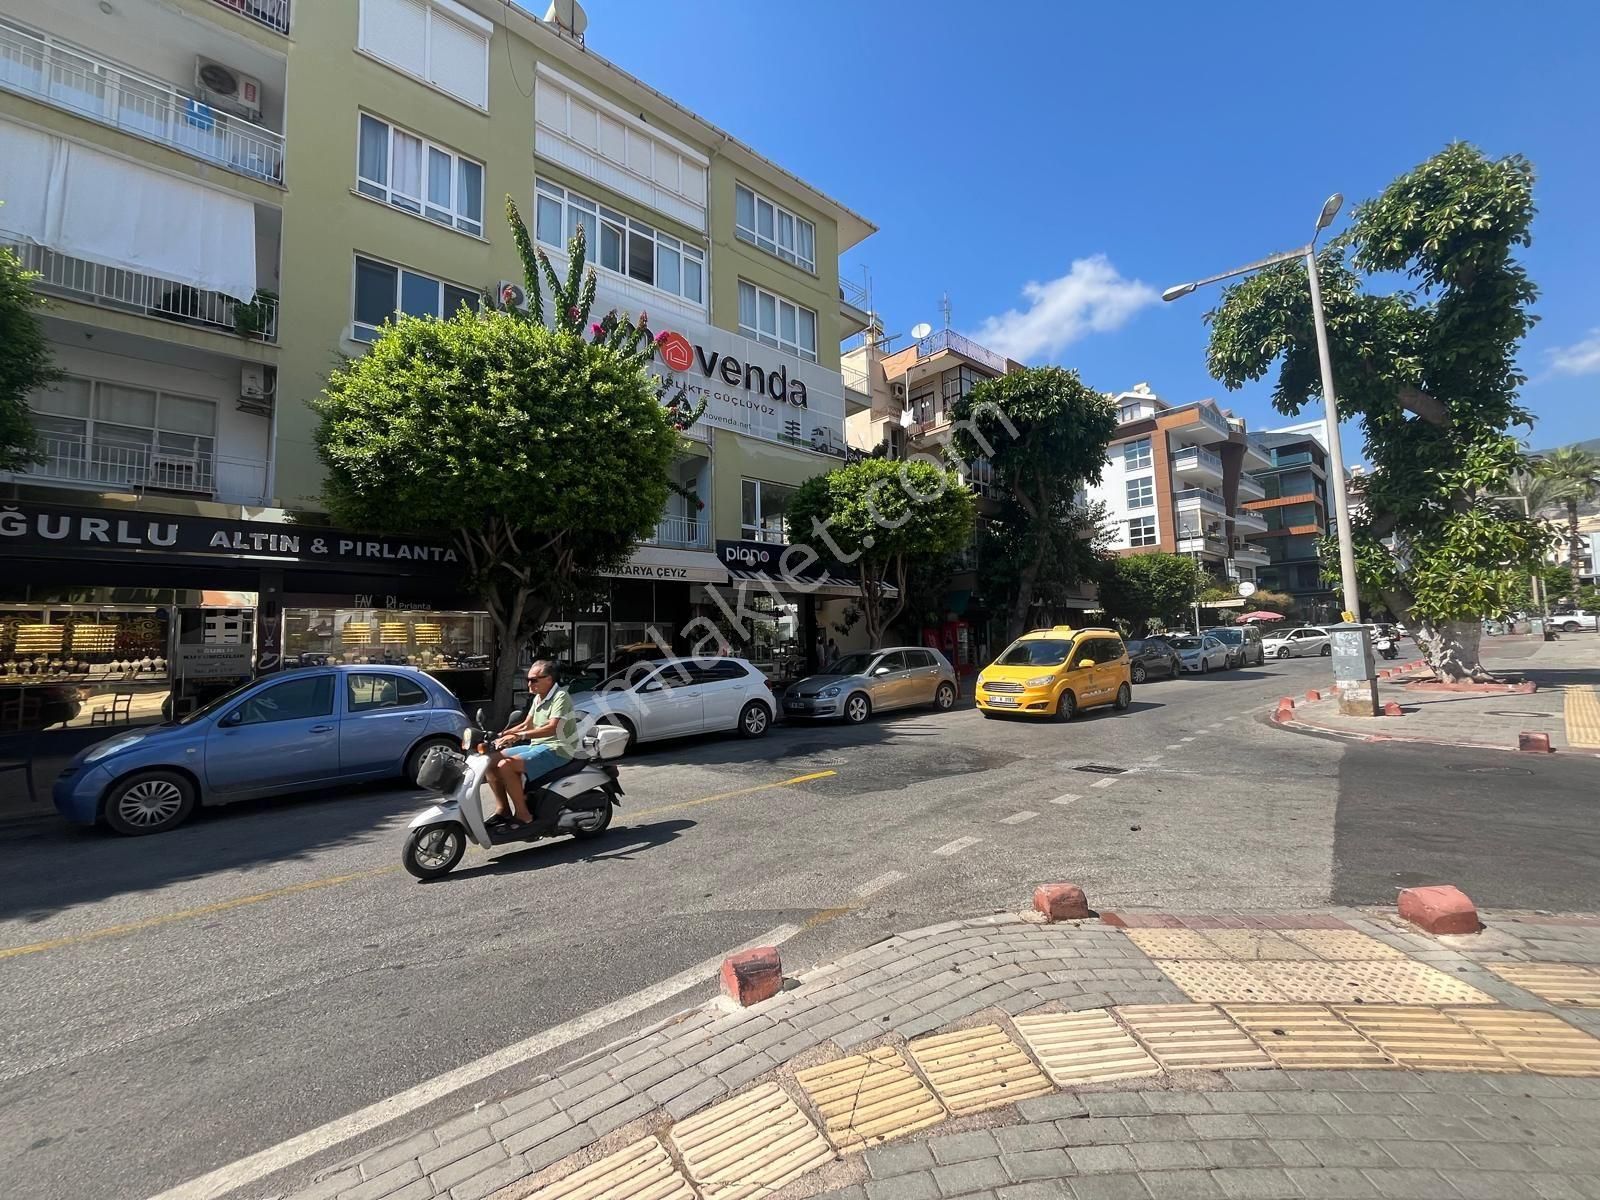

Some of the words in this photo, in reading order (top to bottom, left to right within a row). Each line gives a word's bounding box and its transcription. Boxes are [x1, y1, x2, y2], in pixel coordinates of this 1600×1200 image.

[714, 392, 776, 416] GÜÇLÜYÜZ
[0, 506, 179, 546] ĞURLU
[209, 530, 300, 552] ALTIN
[310, 538, 329, 554] &
[339, 540, 458, 562] PIRLANTA
